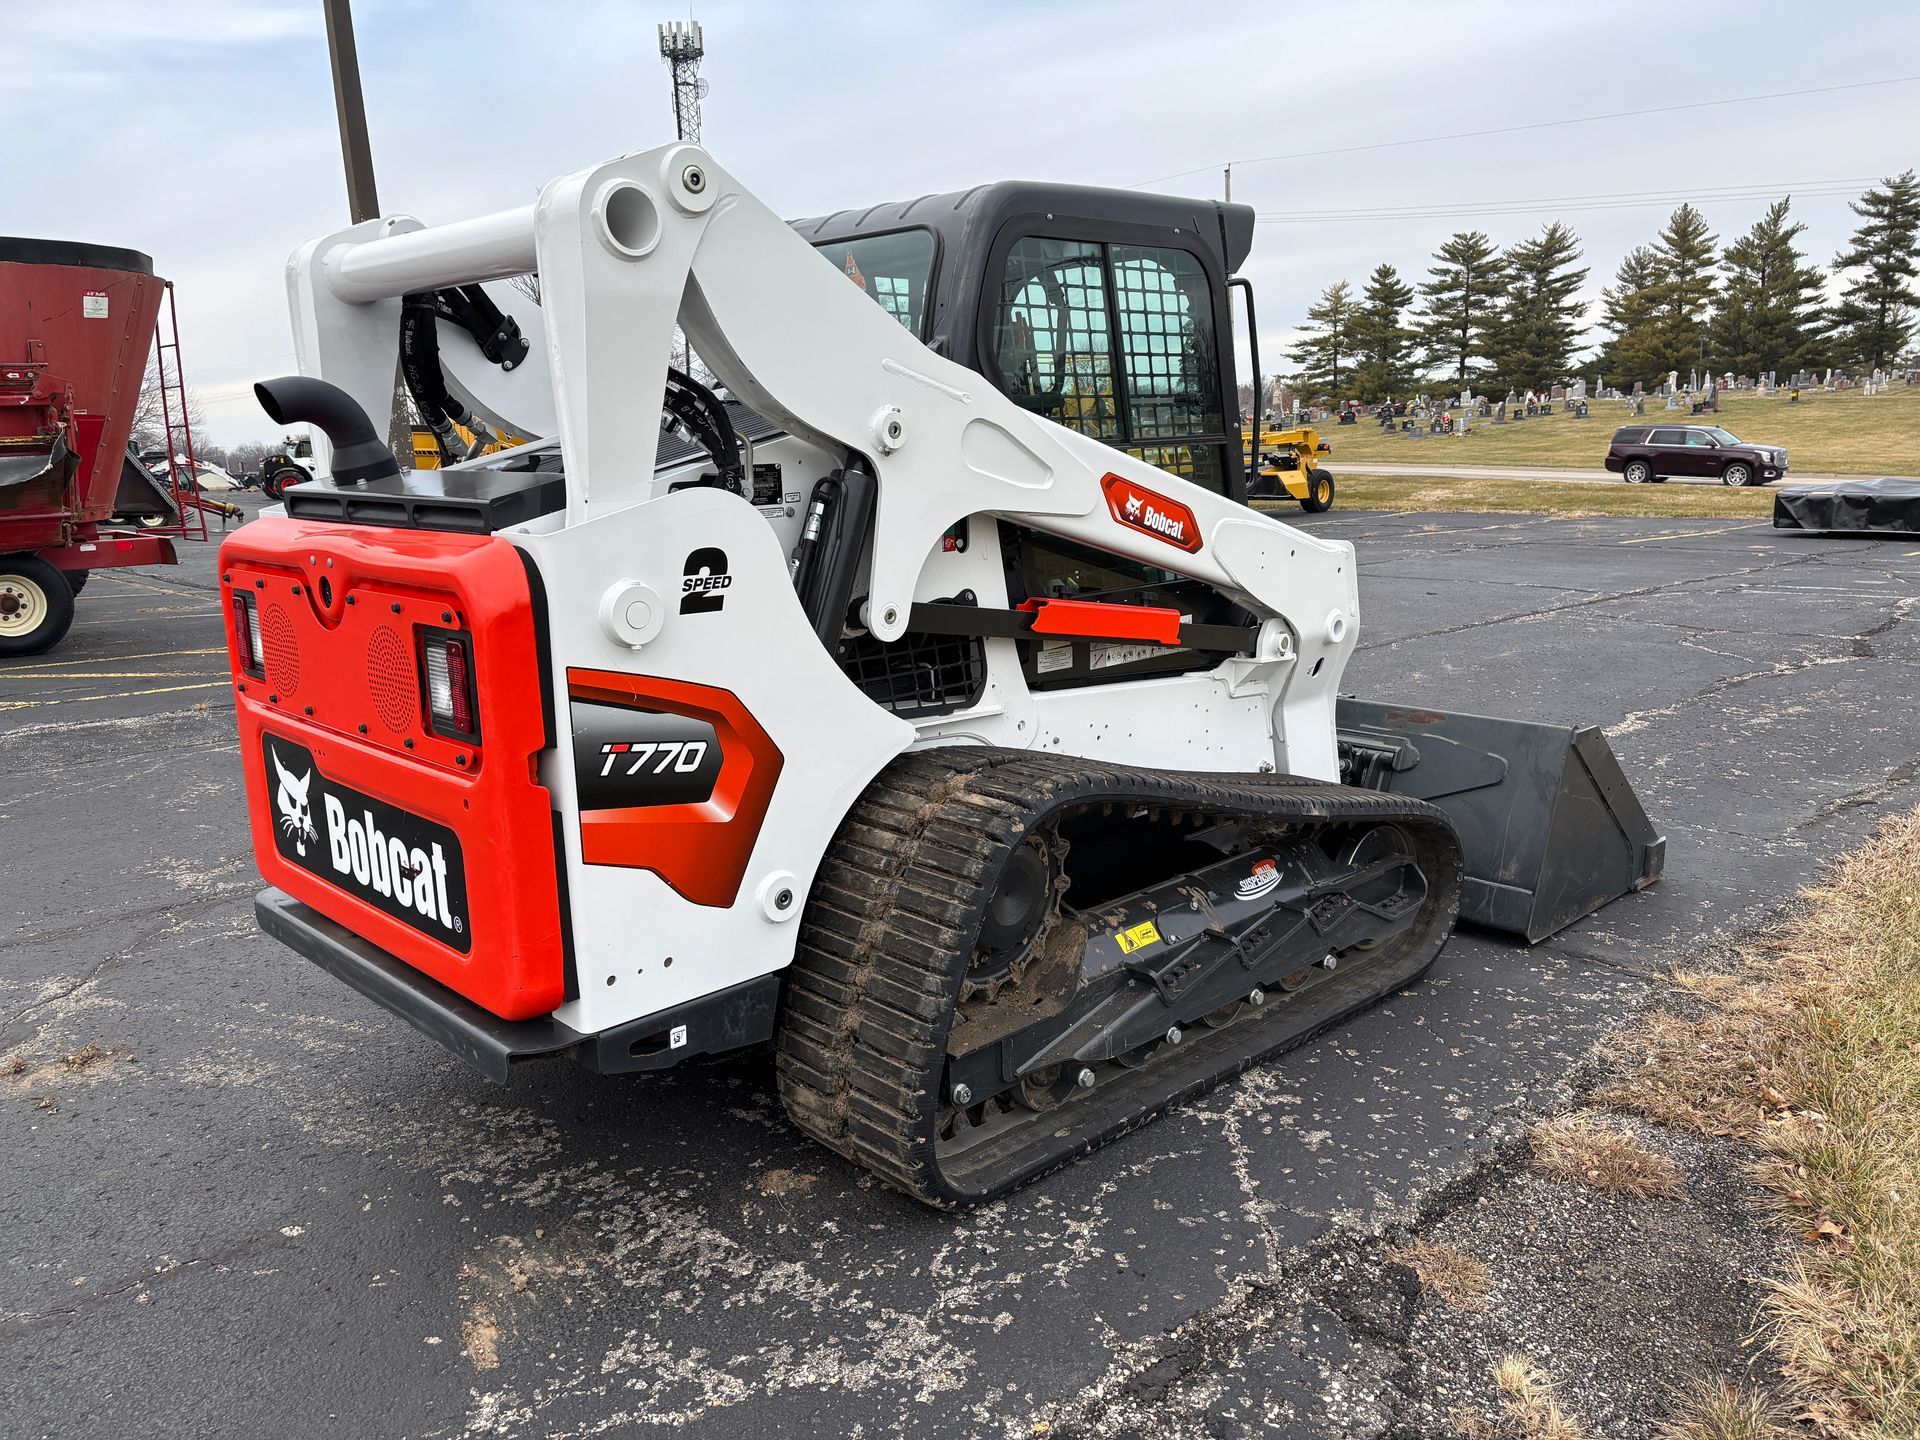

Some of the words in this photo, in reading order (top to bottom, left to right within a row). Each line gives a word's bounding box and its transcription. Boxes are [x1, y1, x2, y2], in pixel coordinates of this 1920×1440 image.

[1144, 506, 1184, 540] Bobcat
[679, 547, 728, 616] 2
[681, 575, 732, 592] SPEED
[600, 741, 707, 776] T770
[323, 792, 453, 930] Bobcat
[1239, 867, 1279, 891] SUSPENSION
